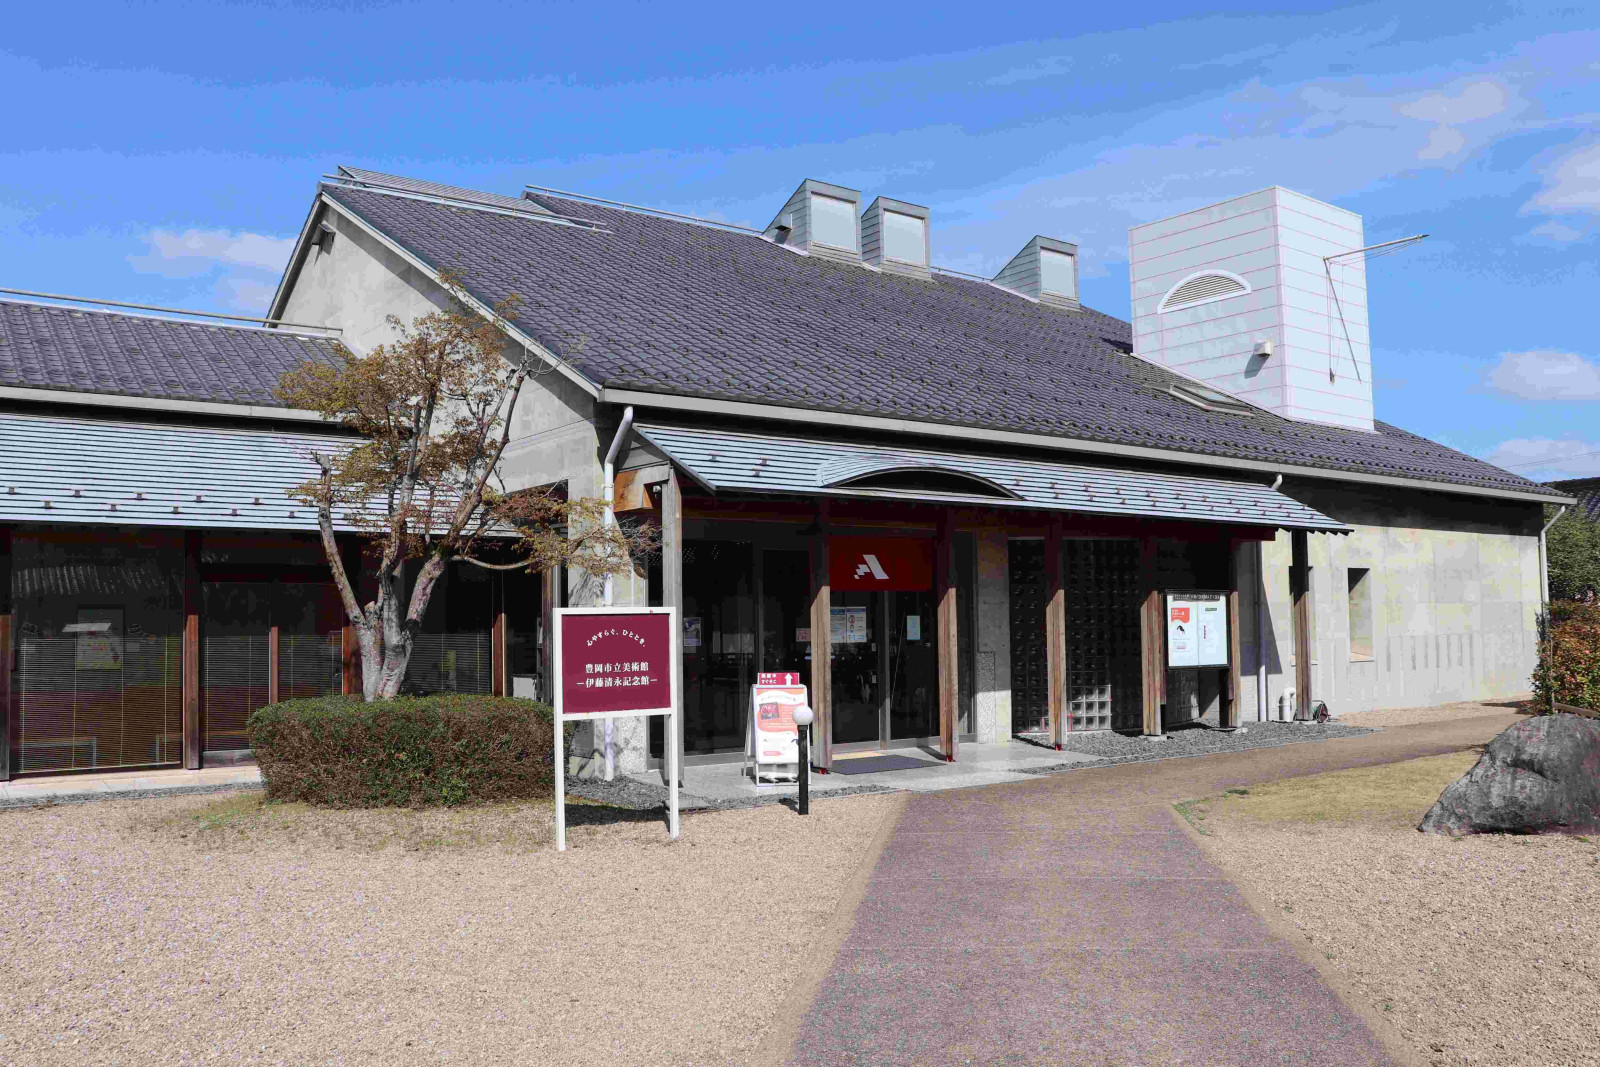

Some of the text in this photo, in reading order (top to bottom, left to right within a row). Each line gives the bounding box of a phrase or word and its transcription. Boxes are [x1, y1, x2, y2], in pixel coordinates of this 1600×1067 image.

[585, 661, 649, 674] 豊岡市立美術館
